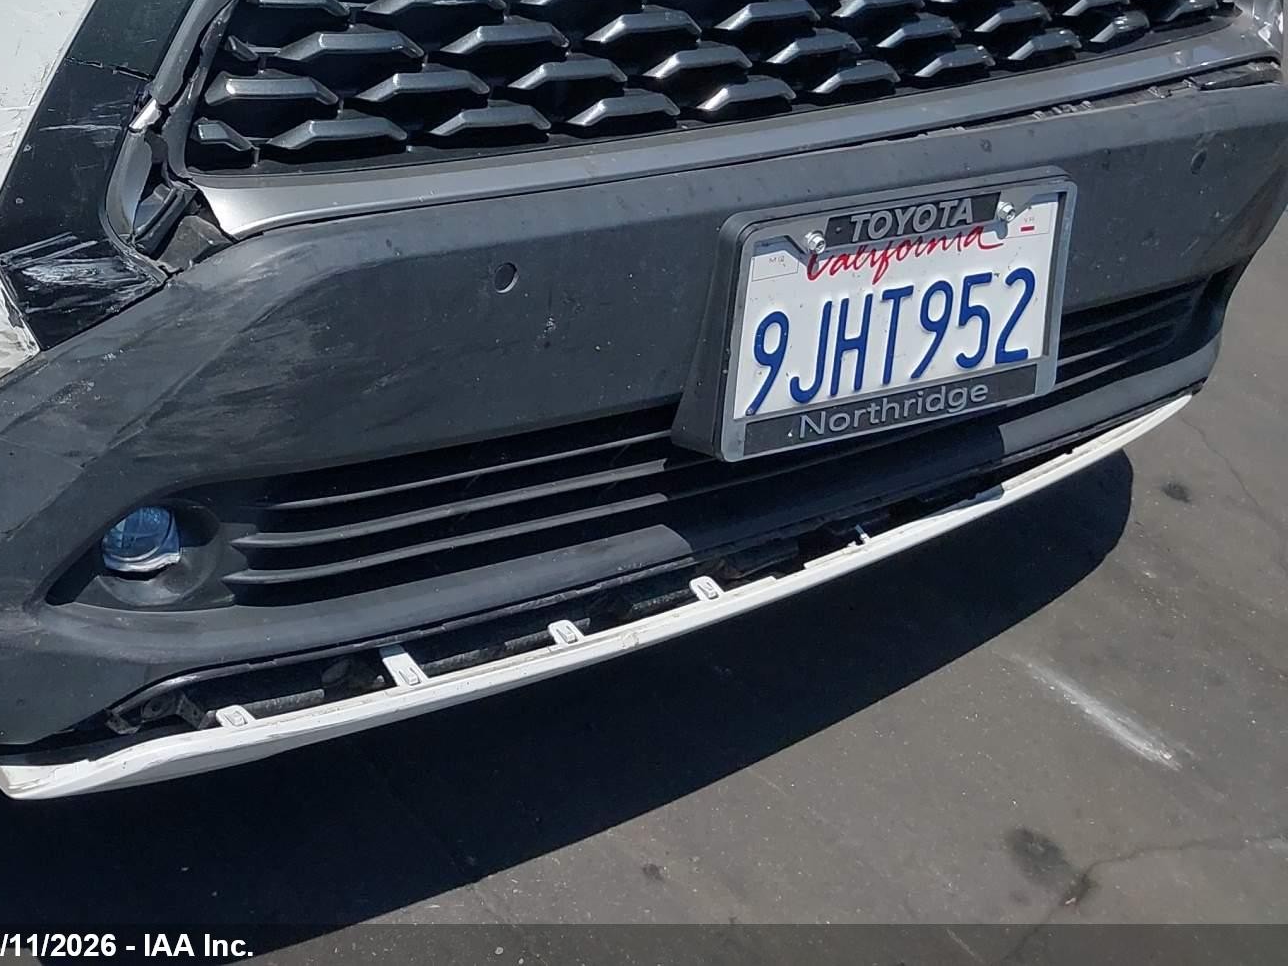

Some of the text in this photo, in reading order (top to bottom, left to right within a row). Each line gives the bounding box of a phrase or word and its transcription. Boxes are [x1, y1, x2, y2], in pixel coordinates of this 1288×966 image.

[850, 197, 974, 242] TOYOTA
[807, 225, 1004, 285] California
[745, 267, 1036, 416] 9JHT952
[798, 382, 989, 438] Northridge
